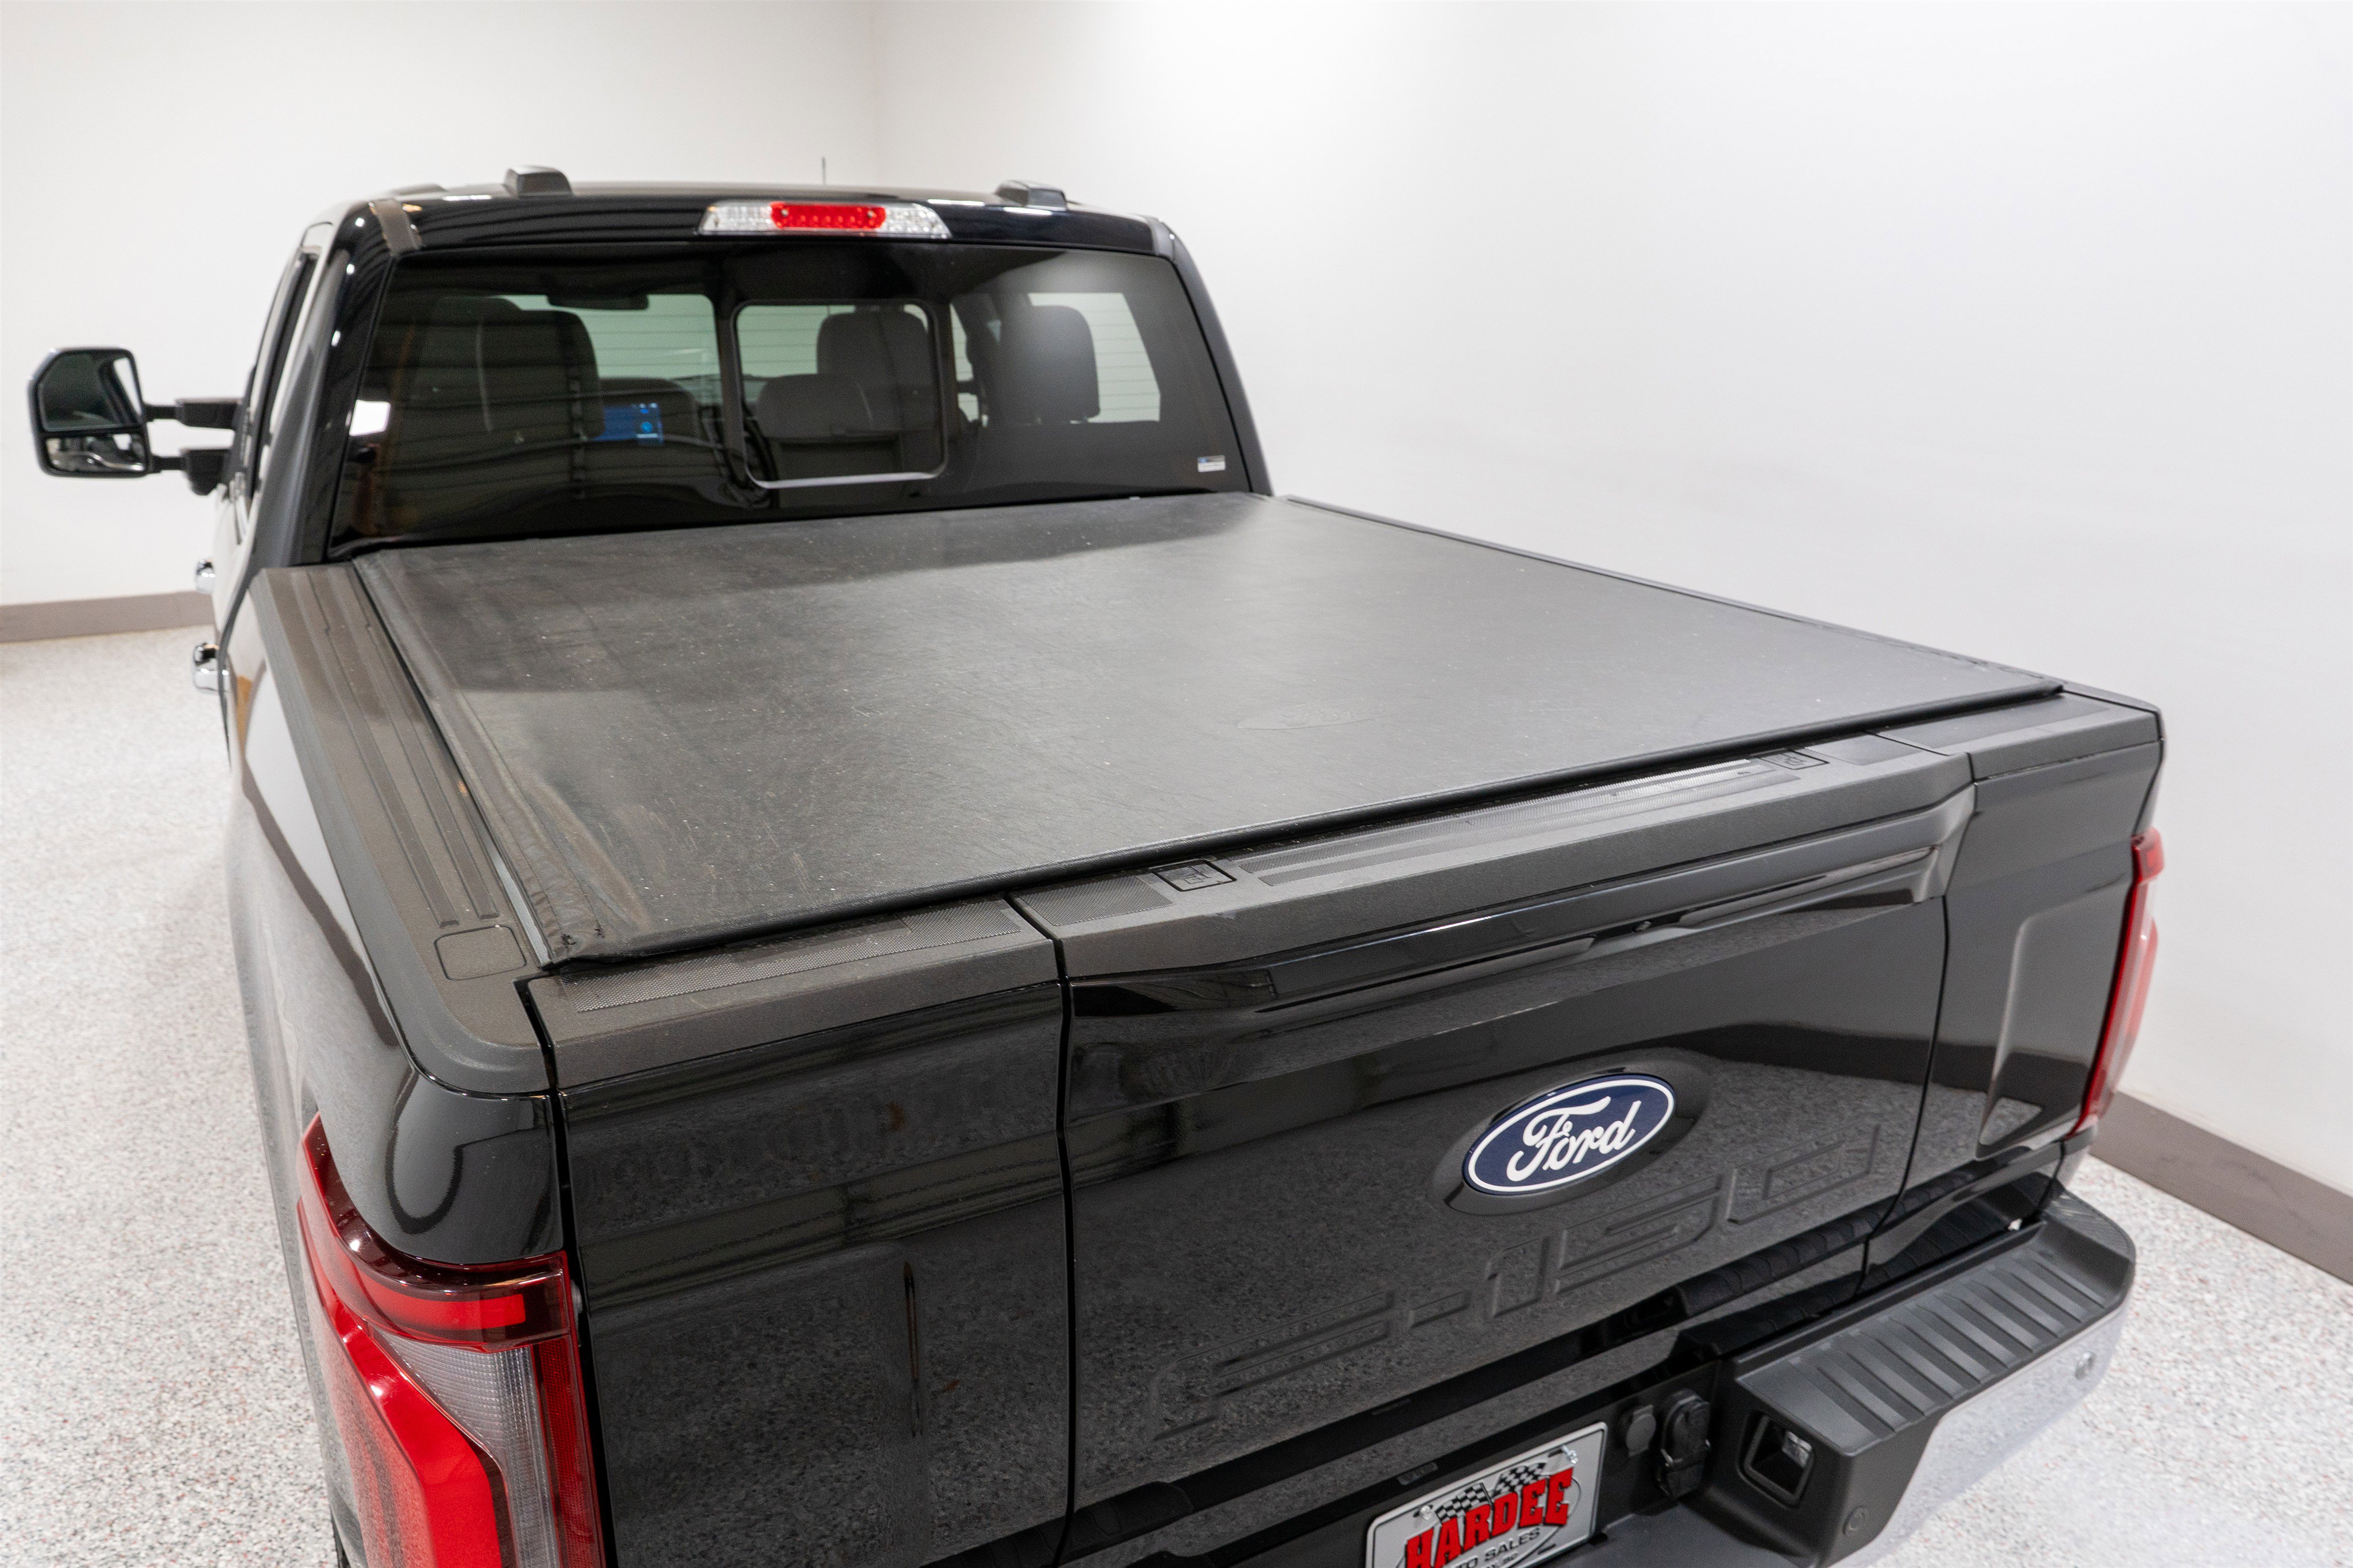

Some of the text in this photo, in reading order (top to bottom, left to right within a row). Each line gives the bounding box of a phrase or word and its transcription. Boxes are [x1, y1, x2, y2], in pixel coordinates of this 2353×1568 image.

[1506, 1096, 1641, 1181] Ford
[1151, 1125, 1881, 1440] F-150
[1406, 1467, 1573, 1568] HARDEE
[1484, 1527, 1540, 1562] SALES
